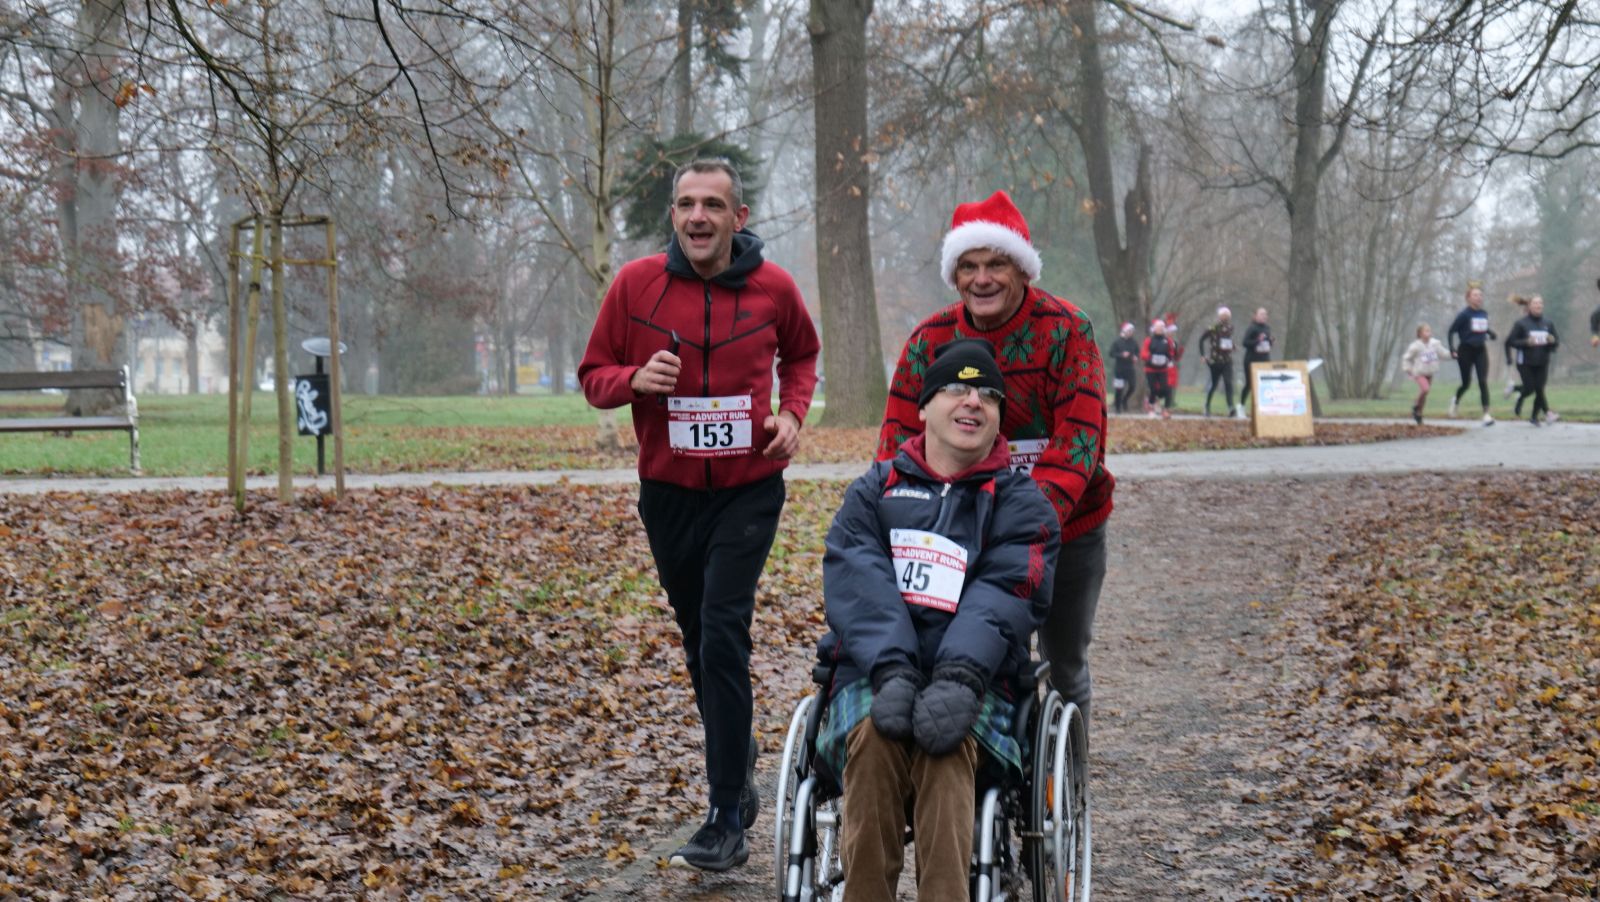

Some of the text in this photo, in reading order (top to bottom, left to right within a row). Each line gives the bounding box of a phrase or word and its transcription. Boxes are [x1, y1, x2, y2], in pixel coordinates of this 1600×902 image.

[695, 412, 728, 421] ADVENT
[729, 411, 746, 420] RUN
[689, 422, 734, 448] 153
[892, 488, 930, 500] LEGEA
[904, 548, 939, 562] ADVENT
[939, 556, 960, 569] RUN
[902, 561, 932, 591] 45
